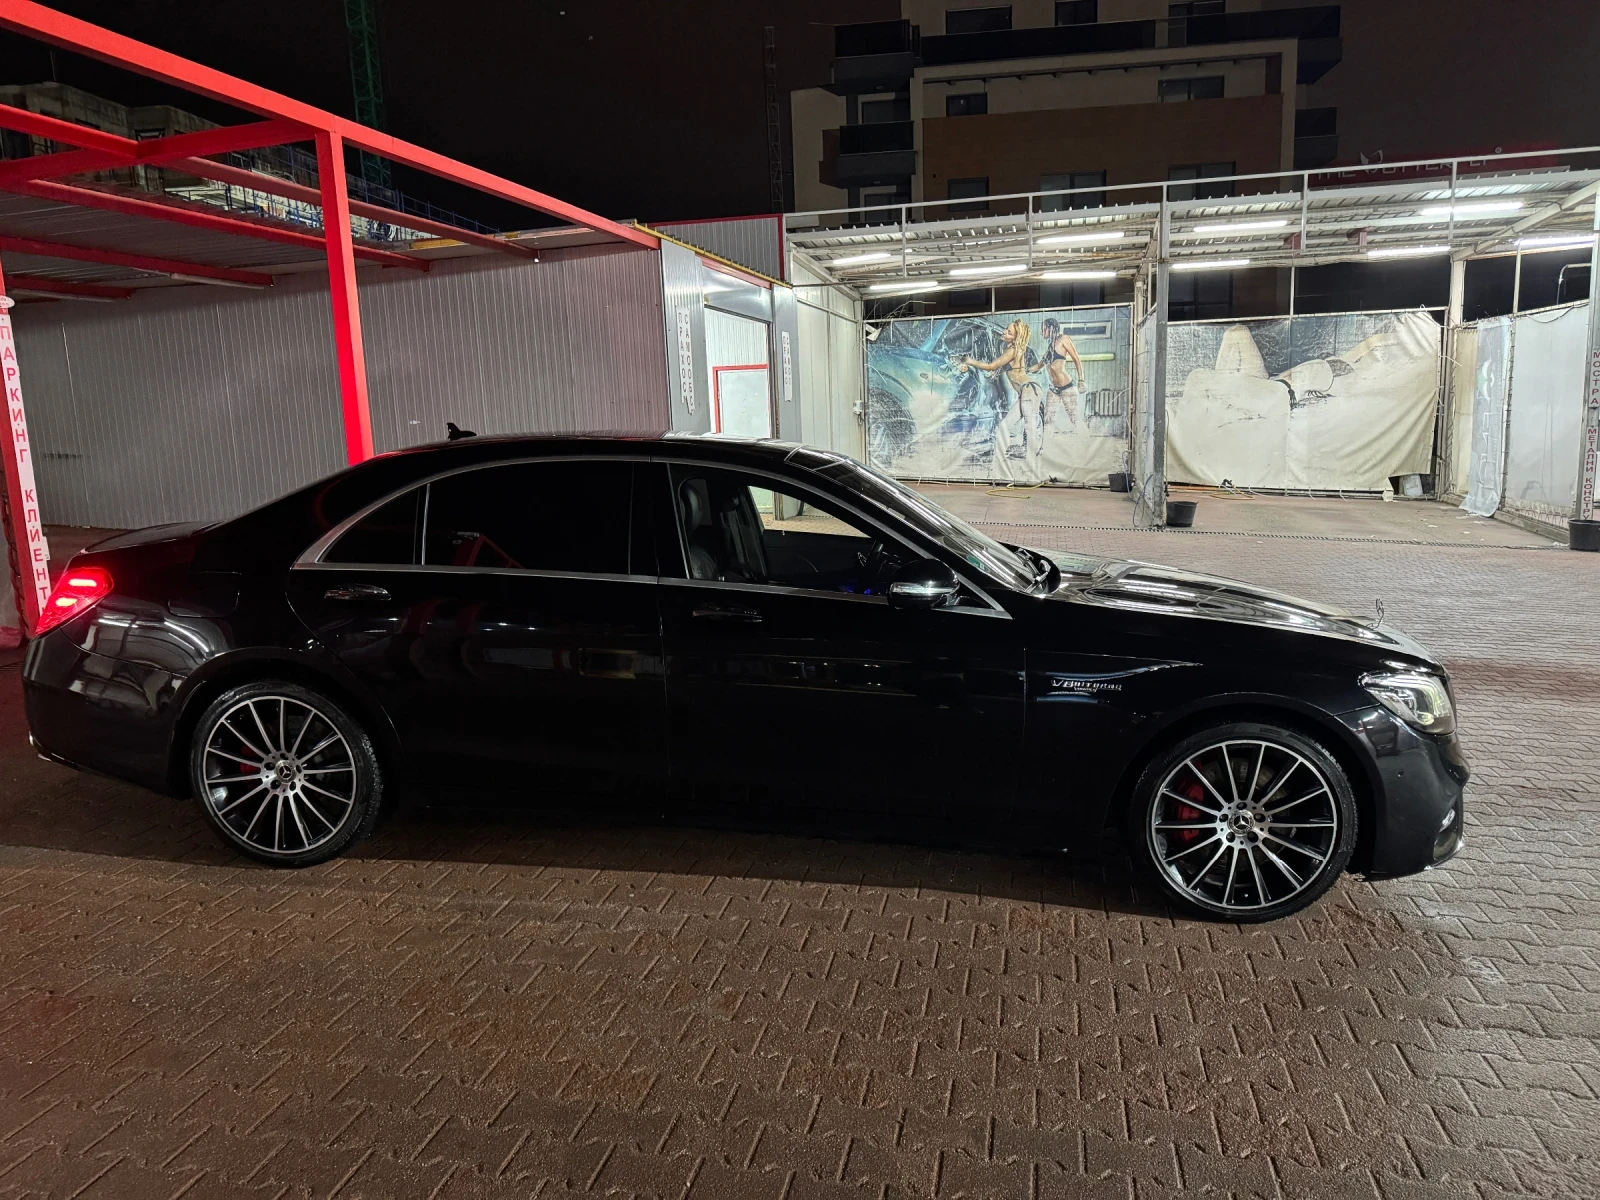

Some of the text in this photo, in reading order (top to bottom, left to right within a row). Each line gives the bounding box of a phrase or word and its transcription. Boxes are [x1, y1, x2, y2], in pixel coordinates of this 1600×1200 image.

[1590, 351, 1600, 405] МОСТРА
[0, 325, 48, 613] ПАРКИНГ КЛИЕНТ
[1586, 428, 1597, 473] МЕТАЛНИ
